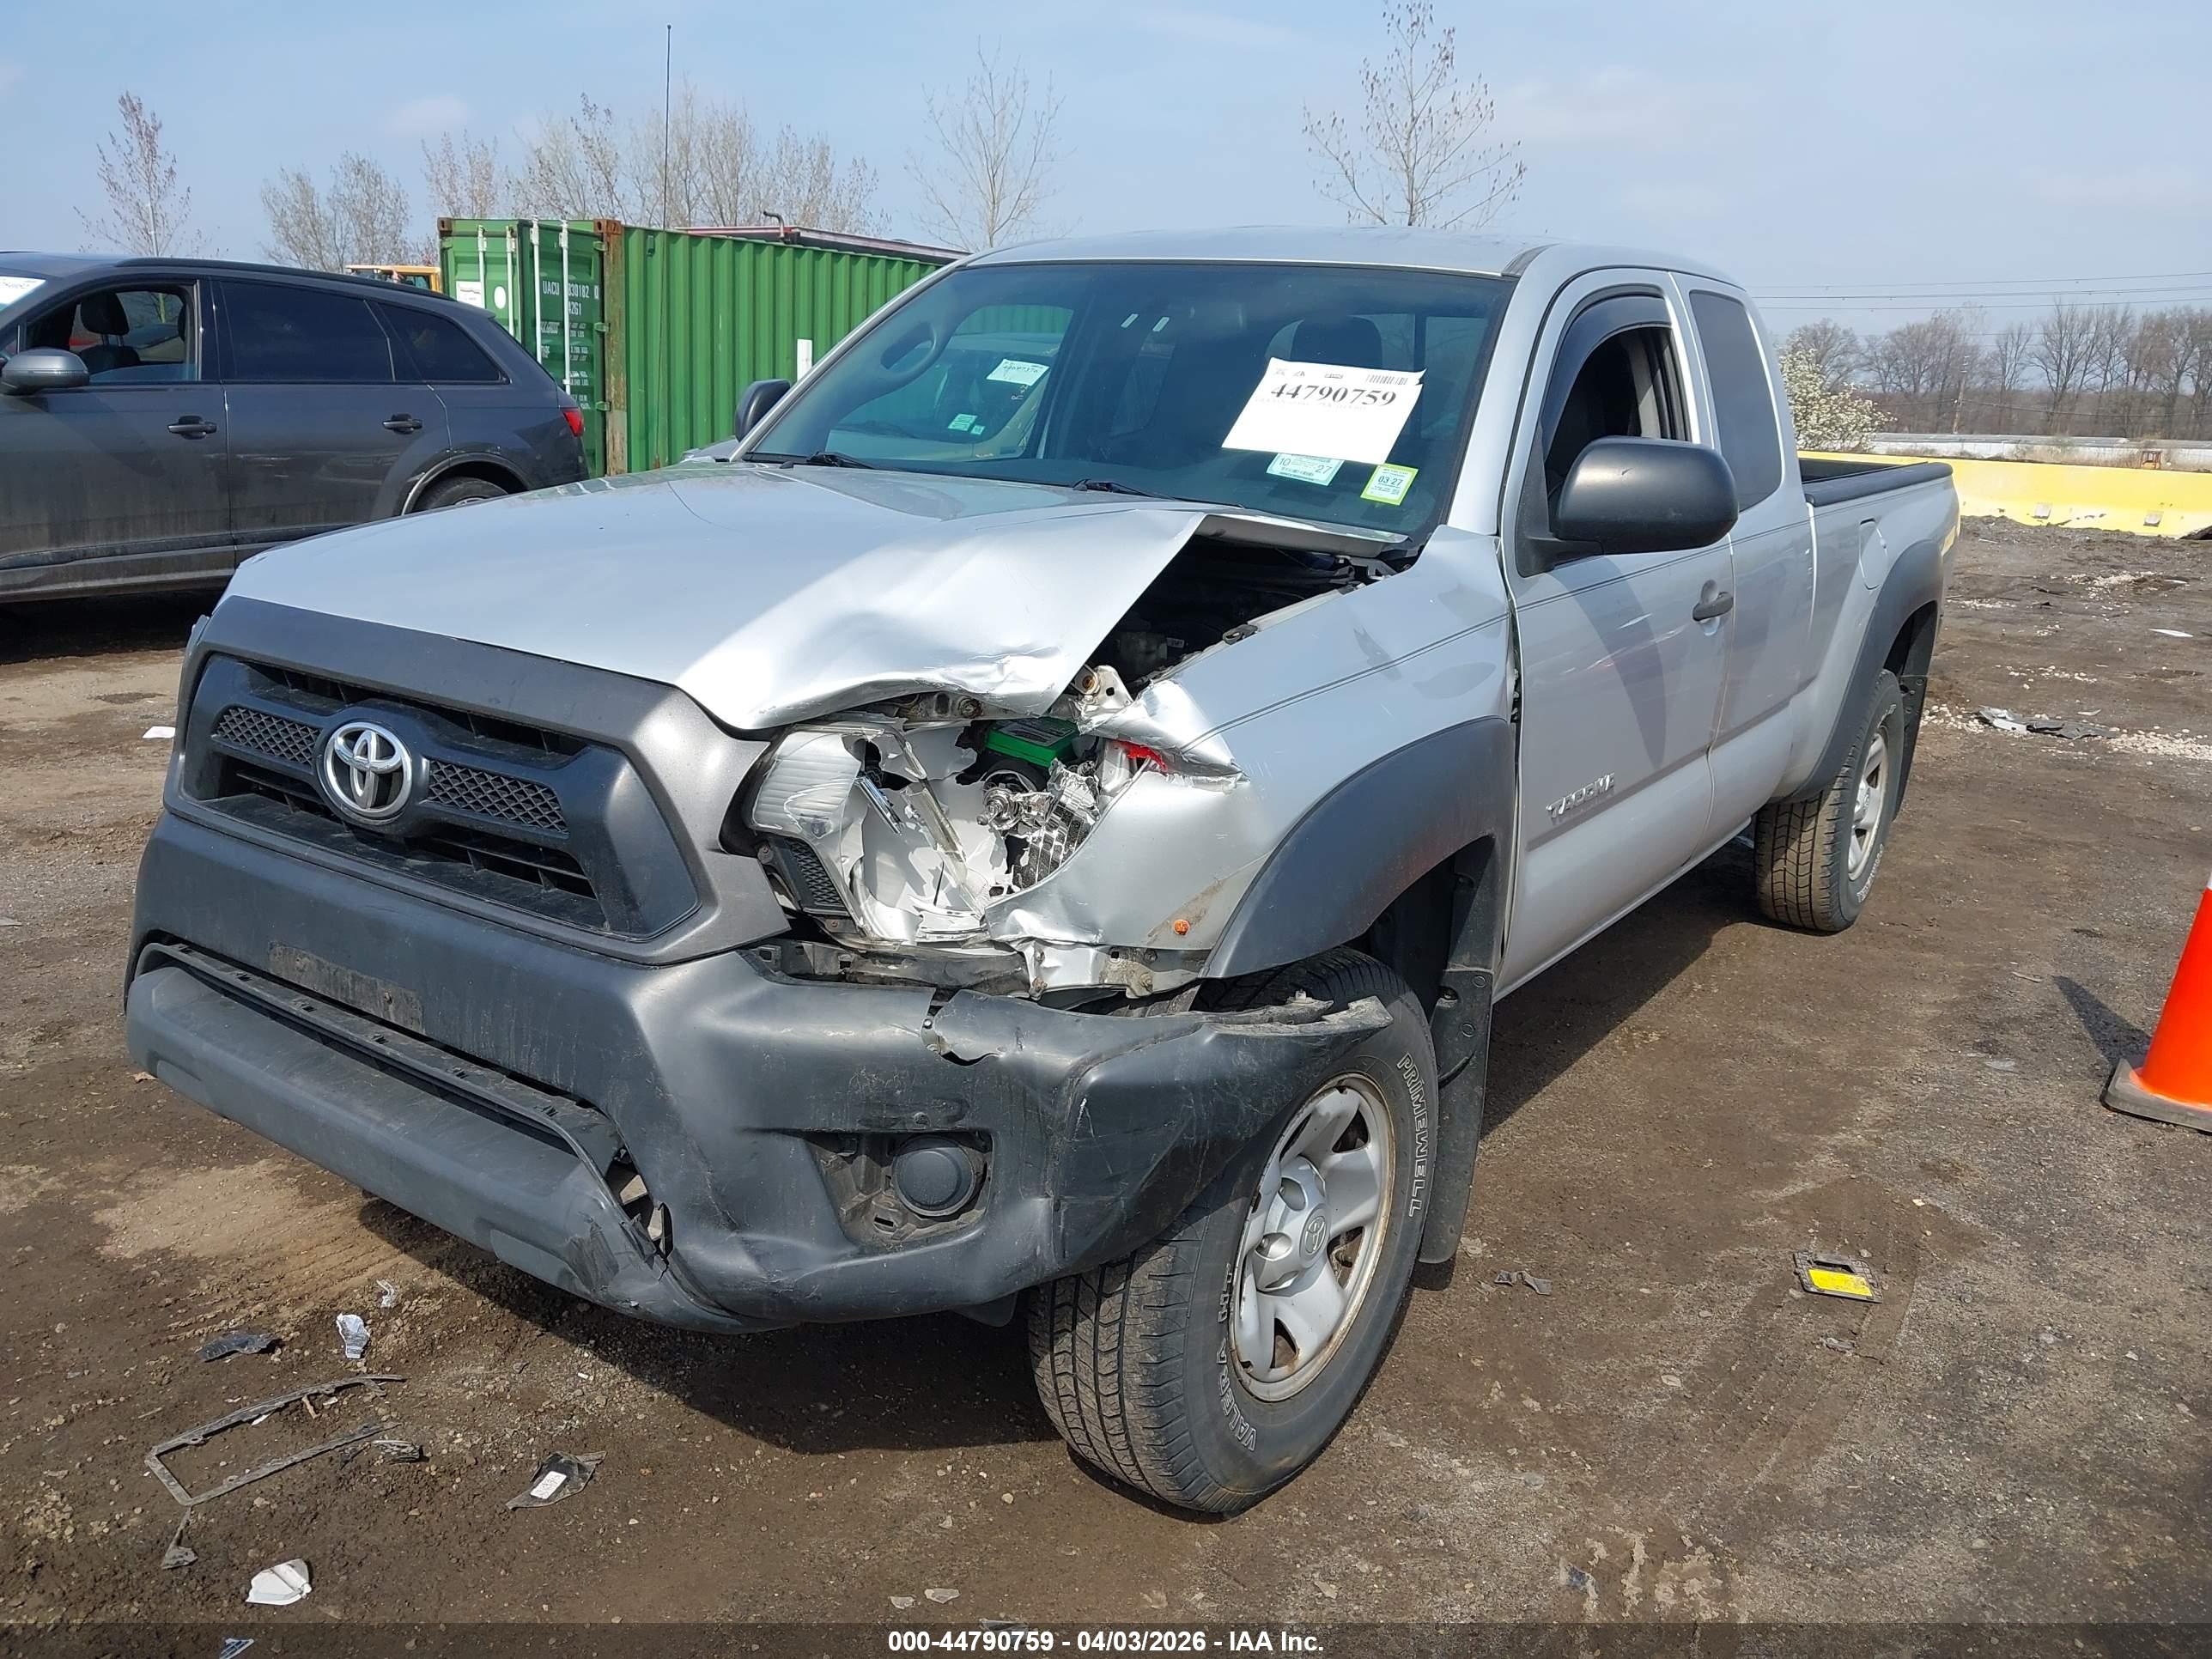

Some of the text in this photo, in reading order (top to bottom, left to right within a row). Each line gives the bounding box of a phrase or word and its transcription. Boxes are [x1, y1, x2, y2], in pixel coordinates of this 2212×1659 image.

[542, 280, 560, 295] UACU
[1271, 383, 1397, 407] 44790759
[1279, 457, 1291, 467] 10
[1315, 465, 1333, 475] 27
[1391, 477, 1404, 487] 27
[1546, 772, 1615, 818] TACOMA
[1396, 1052, 1429, 1218] PRIMEWELL
